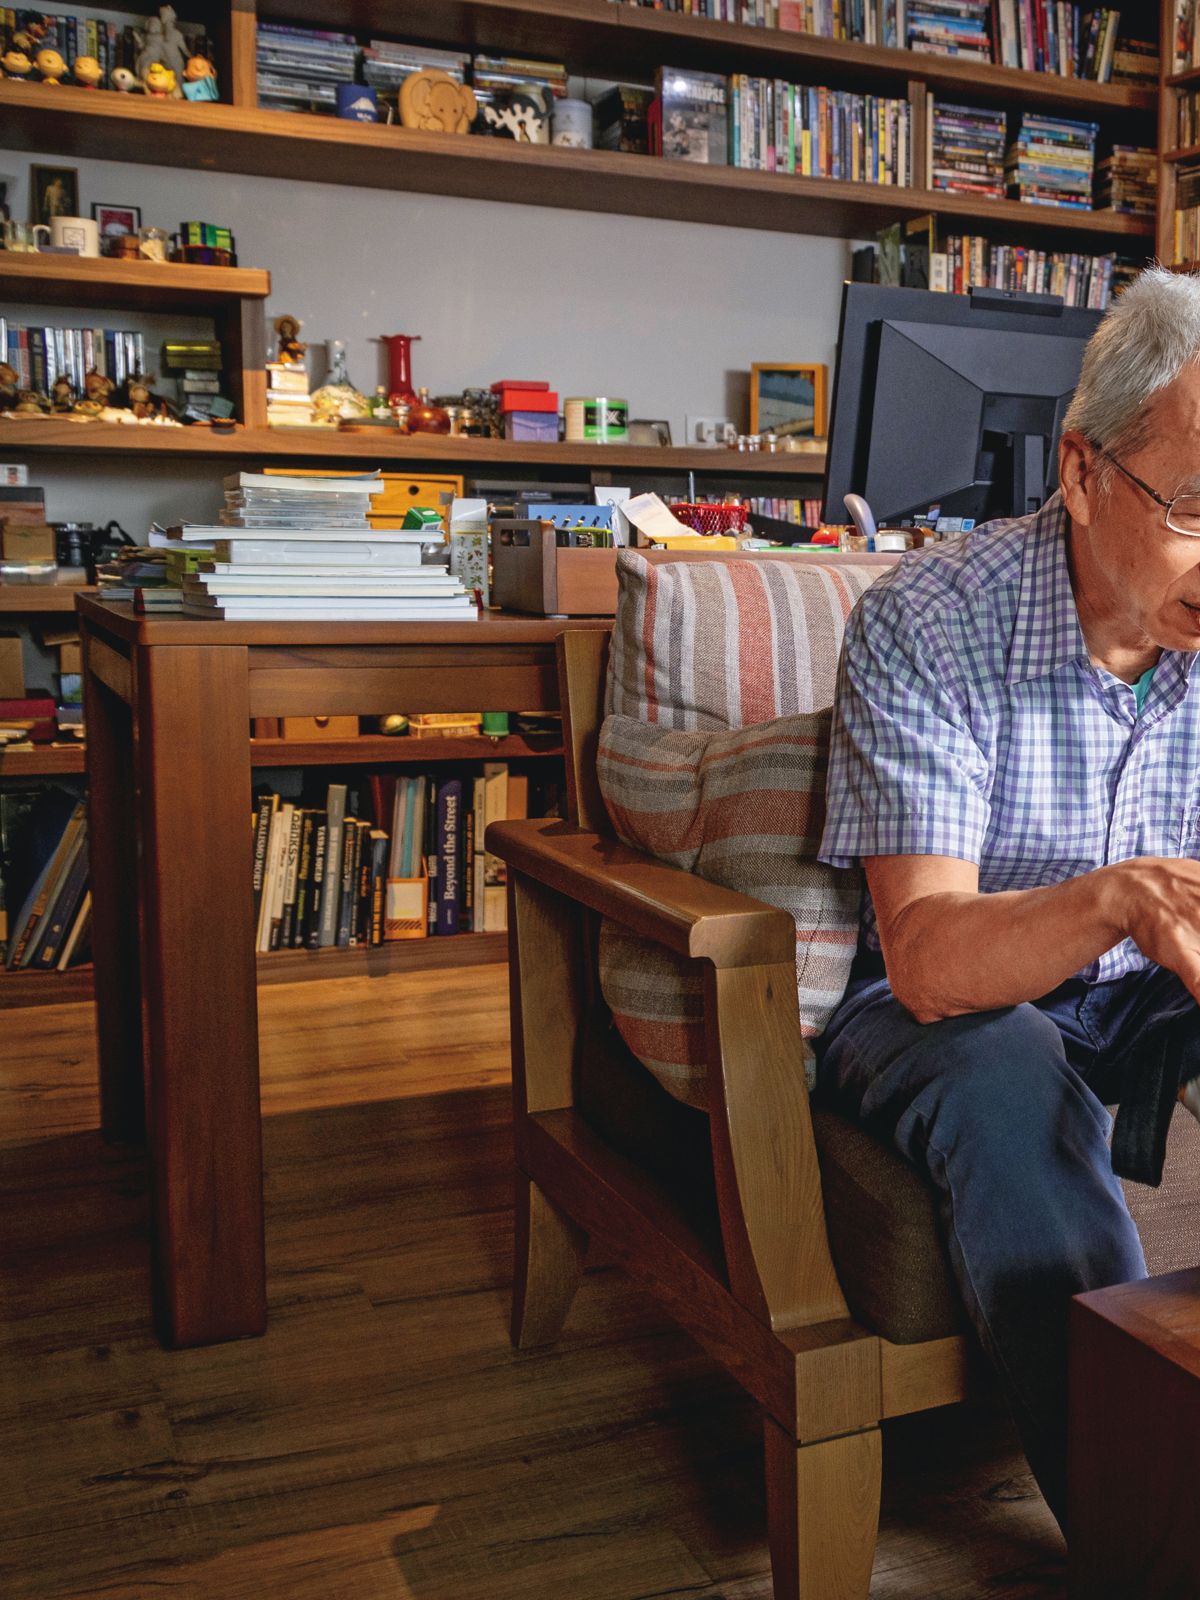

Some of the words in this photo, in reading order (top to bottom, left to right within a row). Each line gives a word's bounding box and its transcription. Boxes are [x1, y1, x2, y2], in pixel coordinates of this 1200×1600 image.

[444, 795, 457, 833] Street
[256, 805, 270, 859] MURALISMO
[316, 826, 326, 856] VANDAL
[443, 833, 456, 854] the
[314, 857, 324, 883] SQUAD
[443, 855, 458, 900] Beyond
